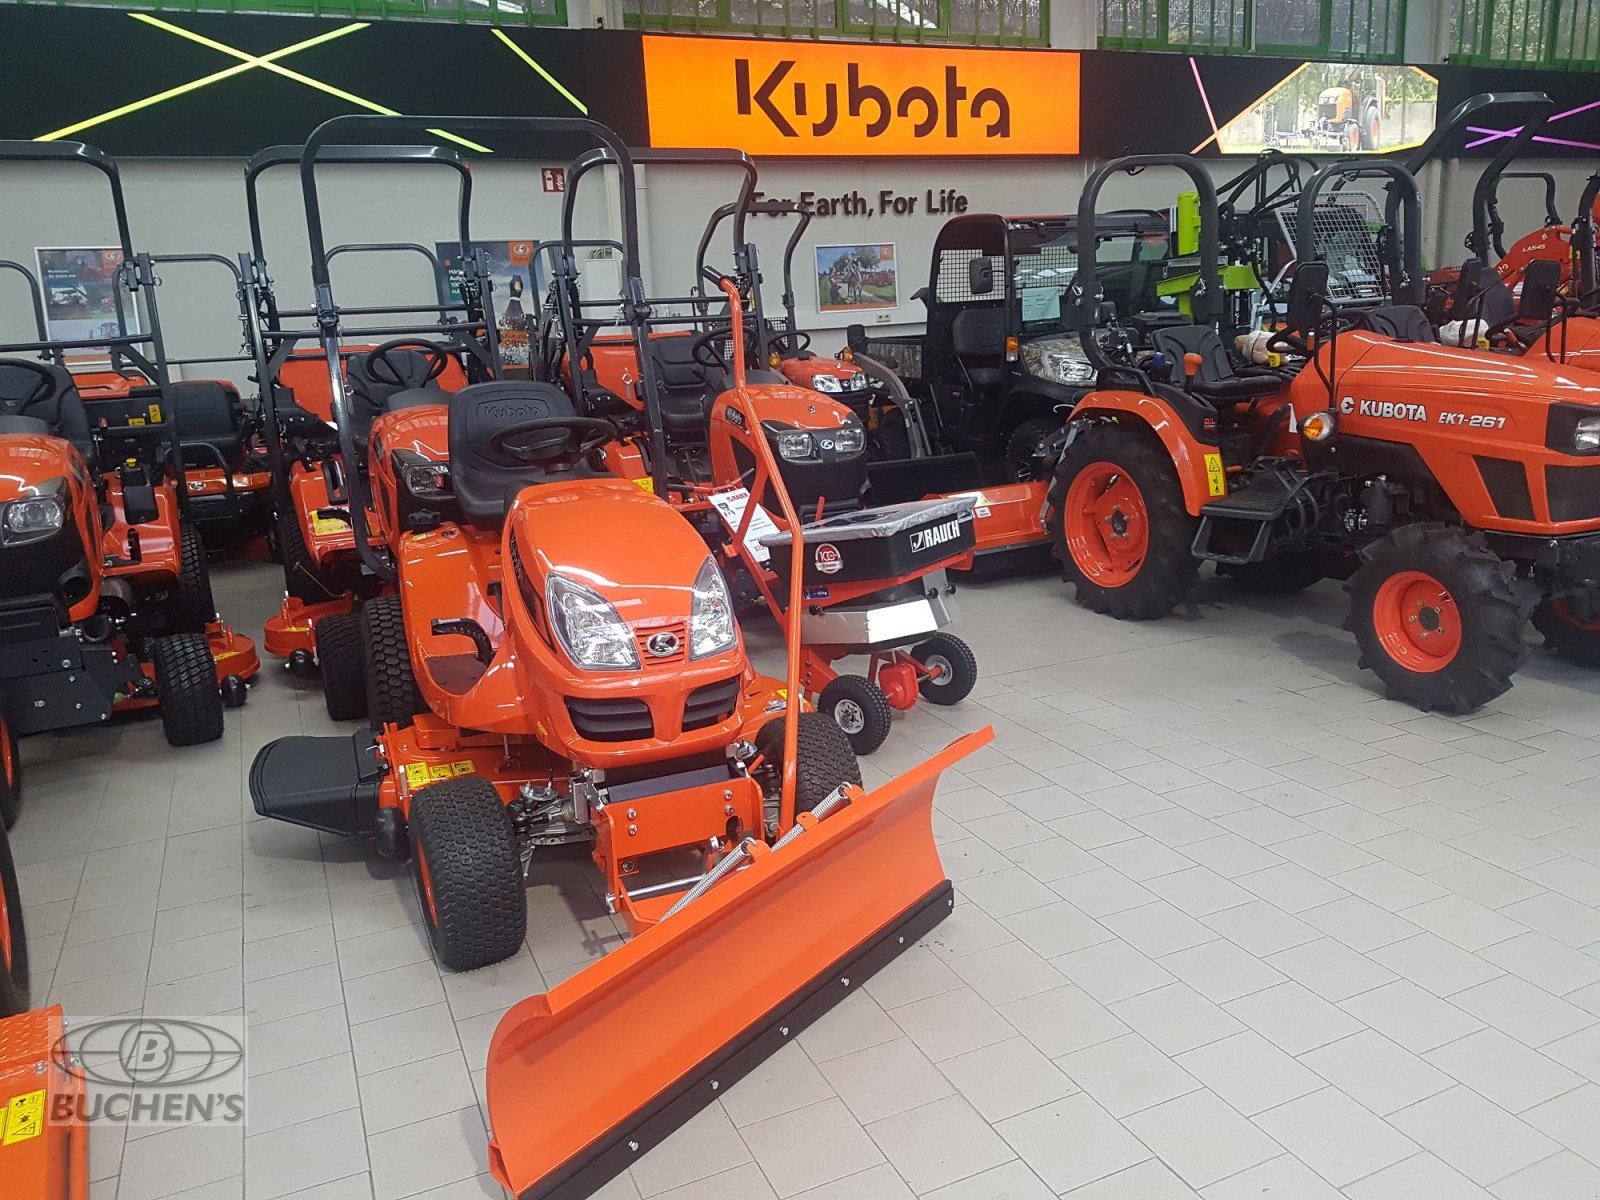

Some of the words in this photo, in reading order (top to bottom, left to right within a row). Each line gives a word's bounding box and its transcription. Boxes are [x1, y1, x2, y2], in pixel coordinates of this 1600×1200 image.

[735, 59, 1010, 138] Kubota
[801, 191, 874, 217] Earth,
[879, 190, 917, 215] For
[926, 189, 968, 214] Life
[484, 403, 540, 418] Kubota
[1359, 399, 1427, 422] KUBOTA
[1438, 411, 1506, 429] EK1-261
[923, 519, 961, 548] RAUCH
